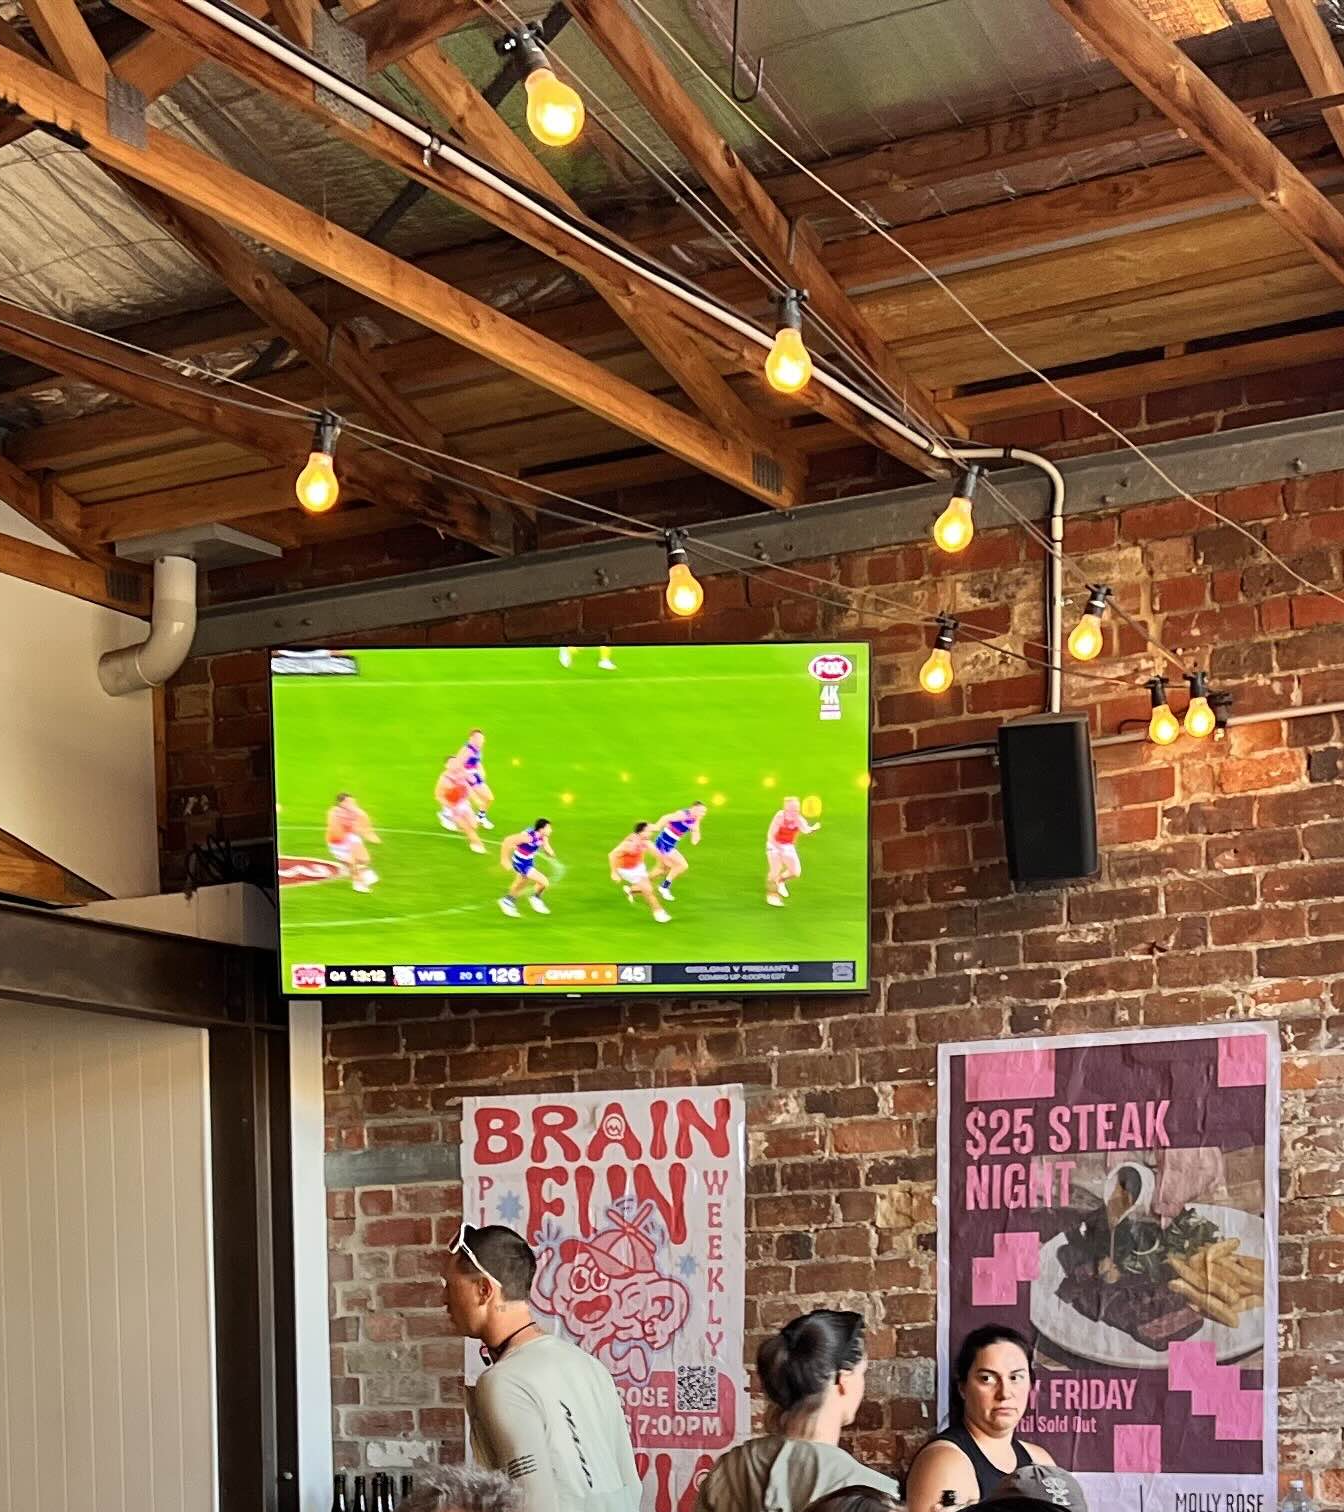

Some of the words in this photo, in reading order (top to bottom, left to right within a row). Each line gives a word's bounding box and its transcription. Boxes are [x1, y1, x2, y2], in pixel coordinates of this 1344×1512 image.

[819, 684, 840, 705] 4K
[488, 968, 521, 983] 126
[619, 967, 647, 983] 45
[472, 1098, 731, 1166] BRAIN
[964, 1106, 1035, 1161] $25
[1048, 1099, 1171, 1155] STEAK
[523, 1161, 688, 1248] FUN
[964, 1160, 1077, 1212] NIGHT
[702, 1169, 729, 1358] WEEKLY
[1049, 1378, 1138, 1411] FRIDAY
[638, 1414, 722, 1437] 7:00PM
[1038, 1414, 1068, 1434] Sold
[1072, 1415, 1097, 1434] Out
